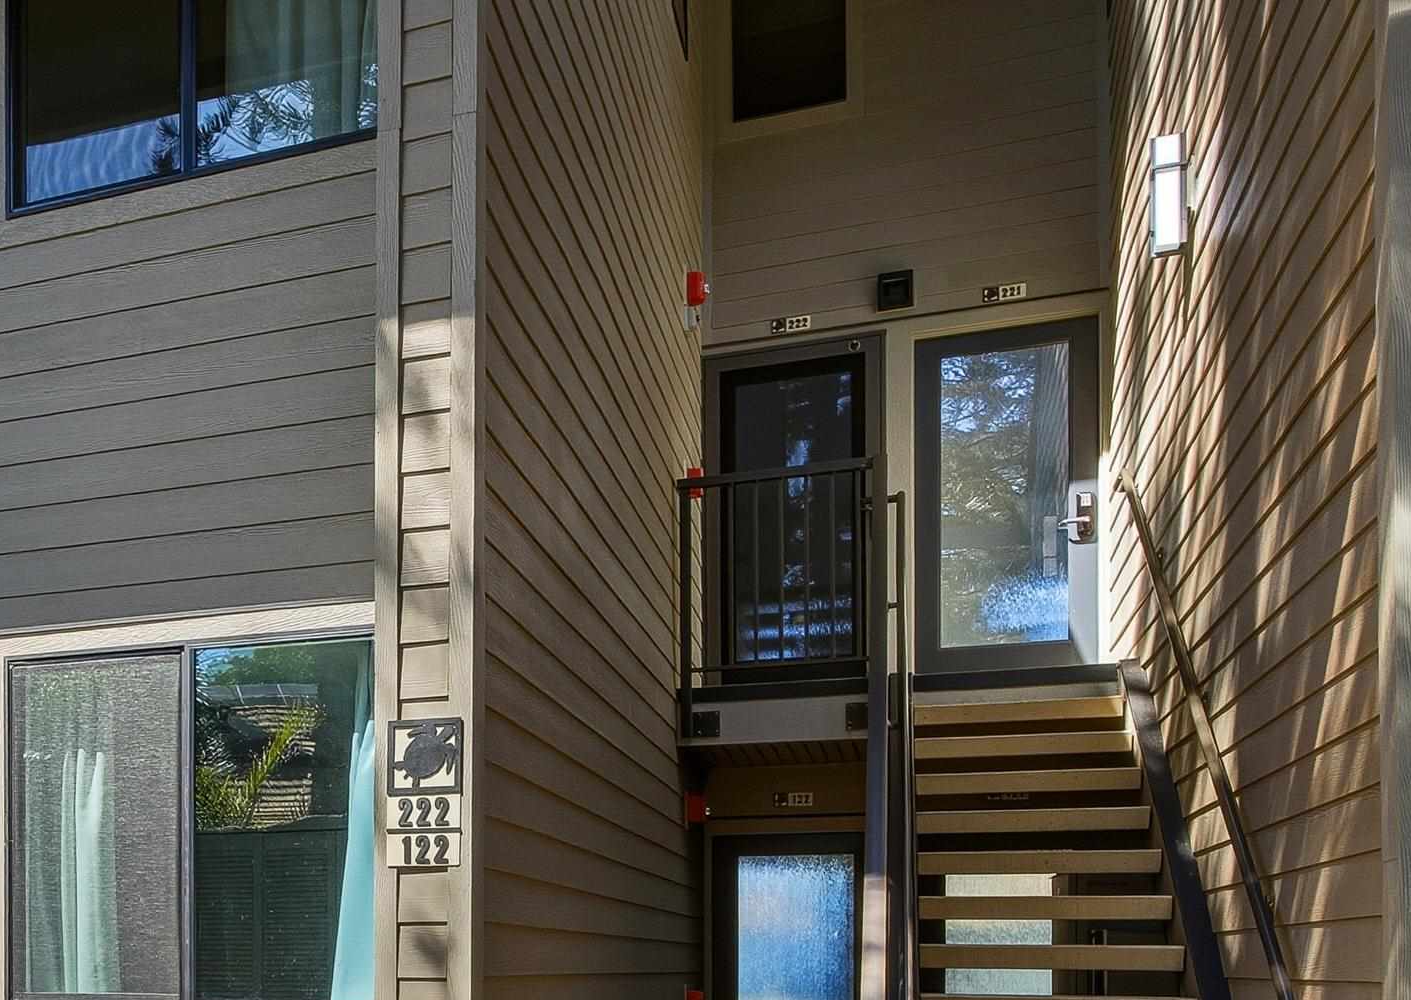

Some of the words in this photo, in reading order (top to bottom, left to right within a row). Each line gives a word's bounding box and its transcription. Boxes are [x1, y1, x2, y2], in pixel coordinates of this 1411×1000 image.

[1002, 286, 1020, 298] 221
[788, 318, 808, 329] 222
[398, 797, 450, 827] 222
[401, 835, 450, 865] 122
